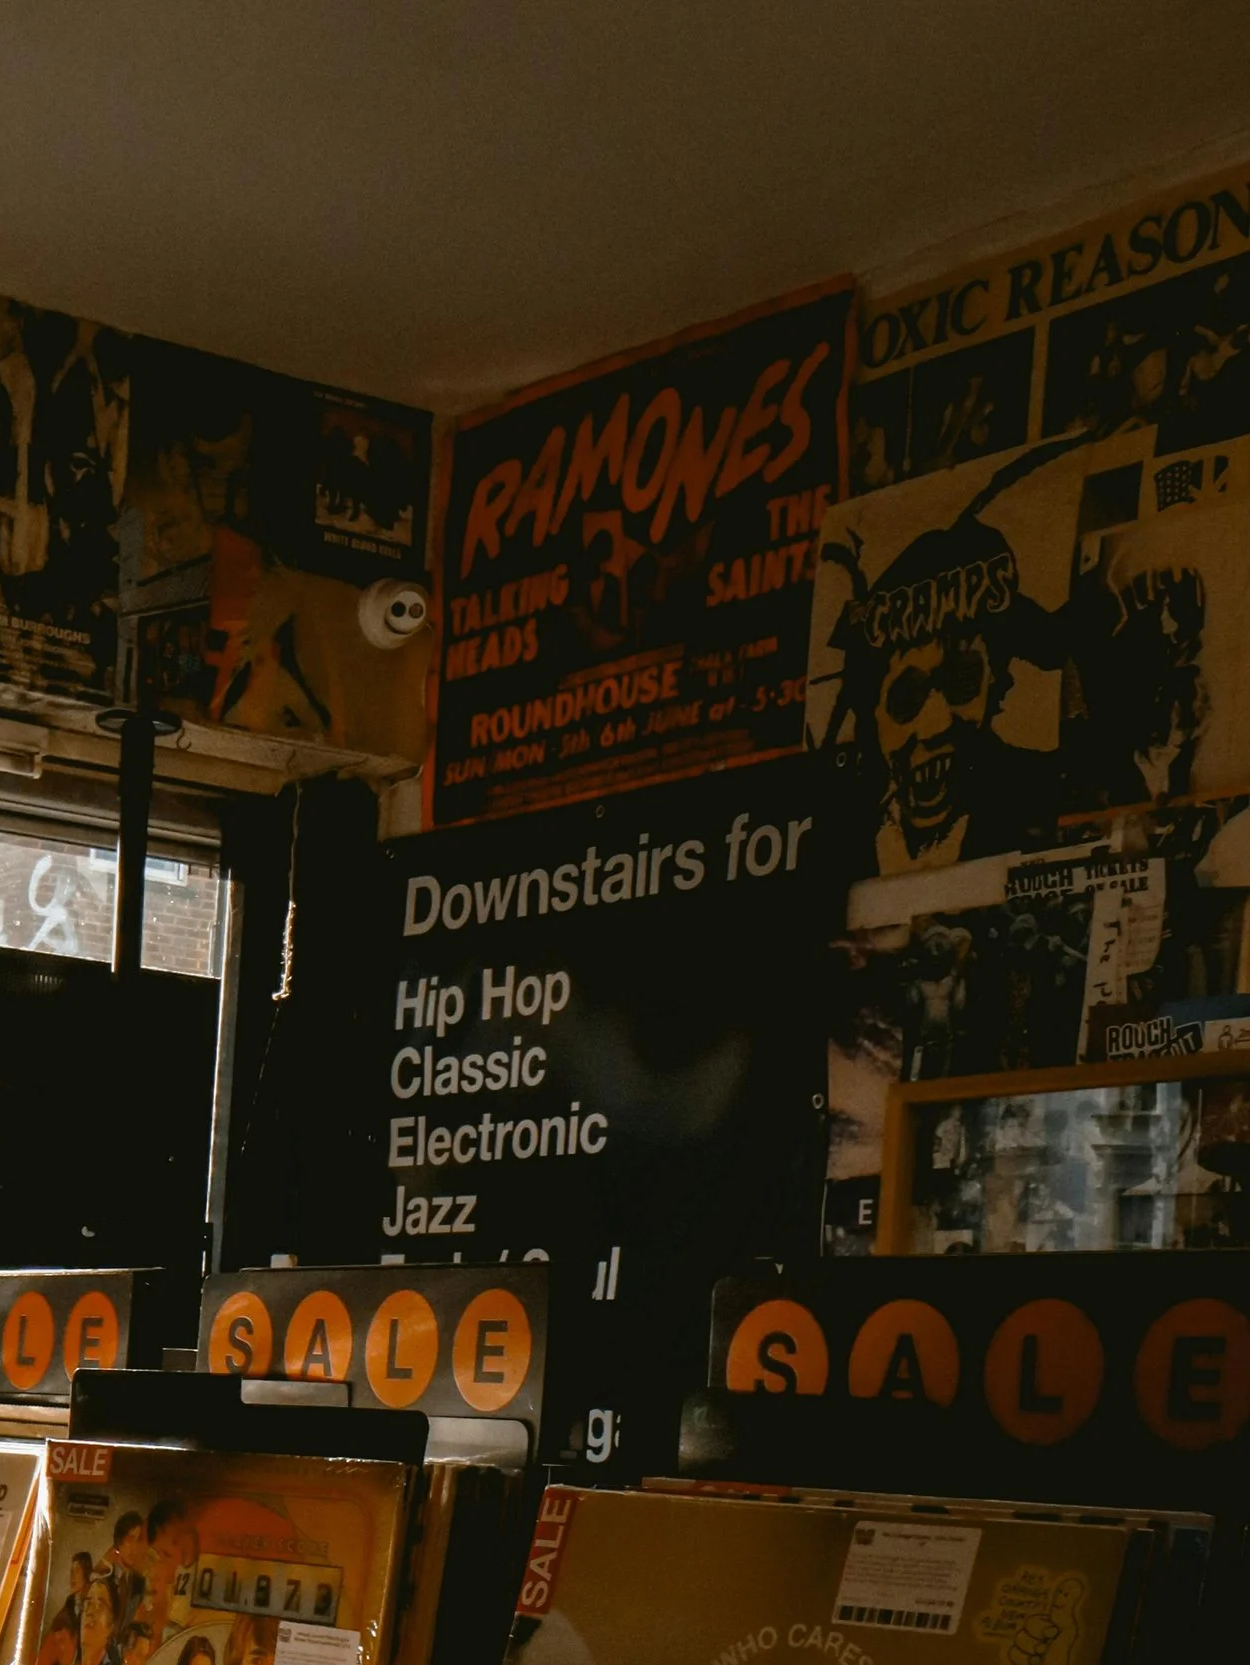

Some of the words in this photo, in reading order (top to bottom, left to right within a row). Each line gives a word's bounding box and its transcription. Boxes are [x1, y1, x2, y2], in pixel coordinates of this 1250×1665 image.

[461, 341, 829, 581] RAMONES
[766, 483, 833, 540] THE
[450, 563, 570, 637] TALKING
[861, 551, 1016, 650] CRAMPS
[446, 617, 539, 682] HEADS
[470, 660, 684, 749] ROUNDHOUSE
[402, 831, 705, 938] Downstairs
[725, 812, 813, 882] for
[393, 975, 466, 1039] Hip
[481, 964, 572, 1025] Hop
[1108, 1016, 1172, 1053] ROUGH
[390, 1036, 547, 1100] Classic
[387, 1100, 610, 1169] Electronic
[381, 1185, 478, 1238] Jazz
[223, 1314, 510, 1385] SALE
[753, 1330, 1230, 1421] SALE
[50, 1446, 106, 1476] SALE
[521, 1497, 572, 1609] SALE
